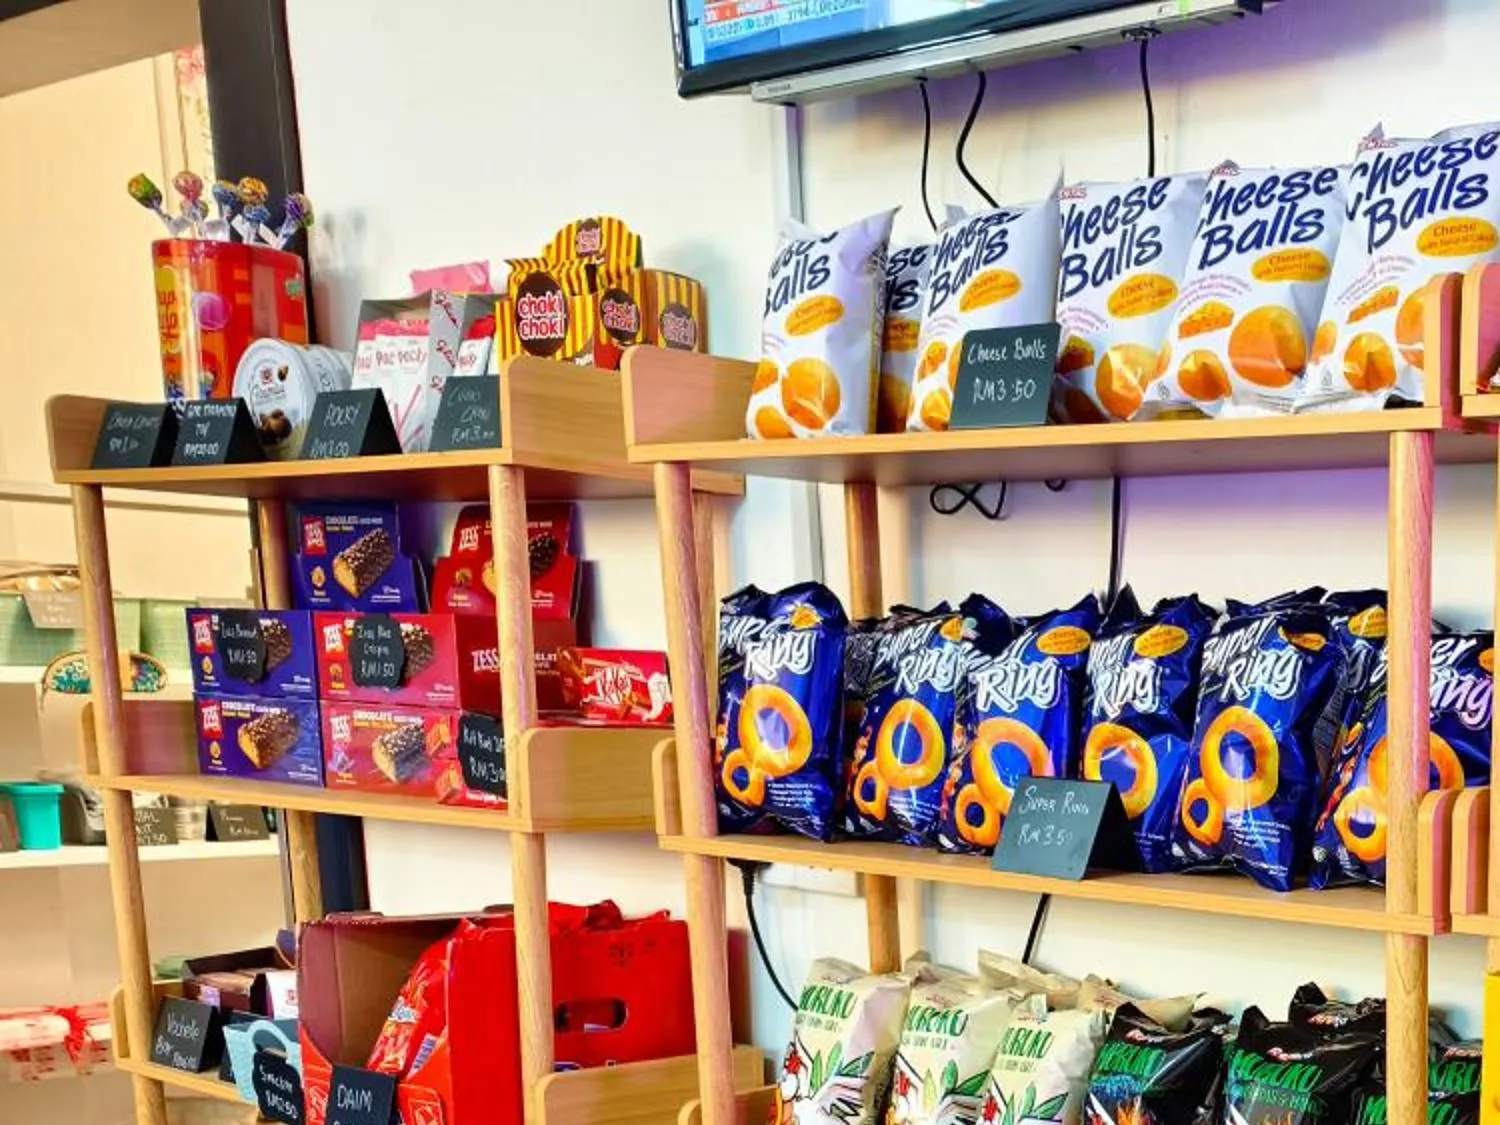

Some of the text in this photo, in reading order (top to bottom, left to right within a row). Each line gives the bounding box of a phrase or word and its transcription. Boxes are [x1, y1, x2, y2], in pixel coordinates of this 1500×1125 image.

[1062, 177, 1171, 250] heese
[1198, 202, 1325, 271] Balls
[1362, 167, 1489, 254] Balls
[1060, 224, 1163, 302] Balls
[517, 294, 565, 319] choki
[518, 317, 566, 341] choki
[1013, 336, 1047, 361] Balls
[743, 628, 818, 681] Ring
[1219, 645, 1303, 703] Ring
[968, 656, 1066, 714] Ring
[1429, 668, 1499, 730] ing
[336, 1084, 373, 1112] DAIM
